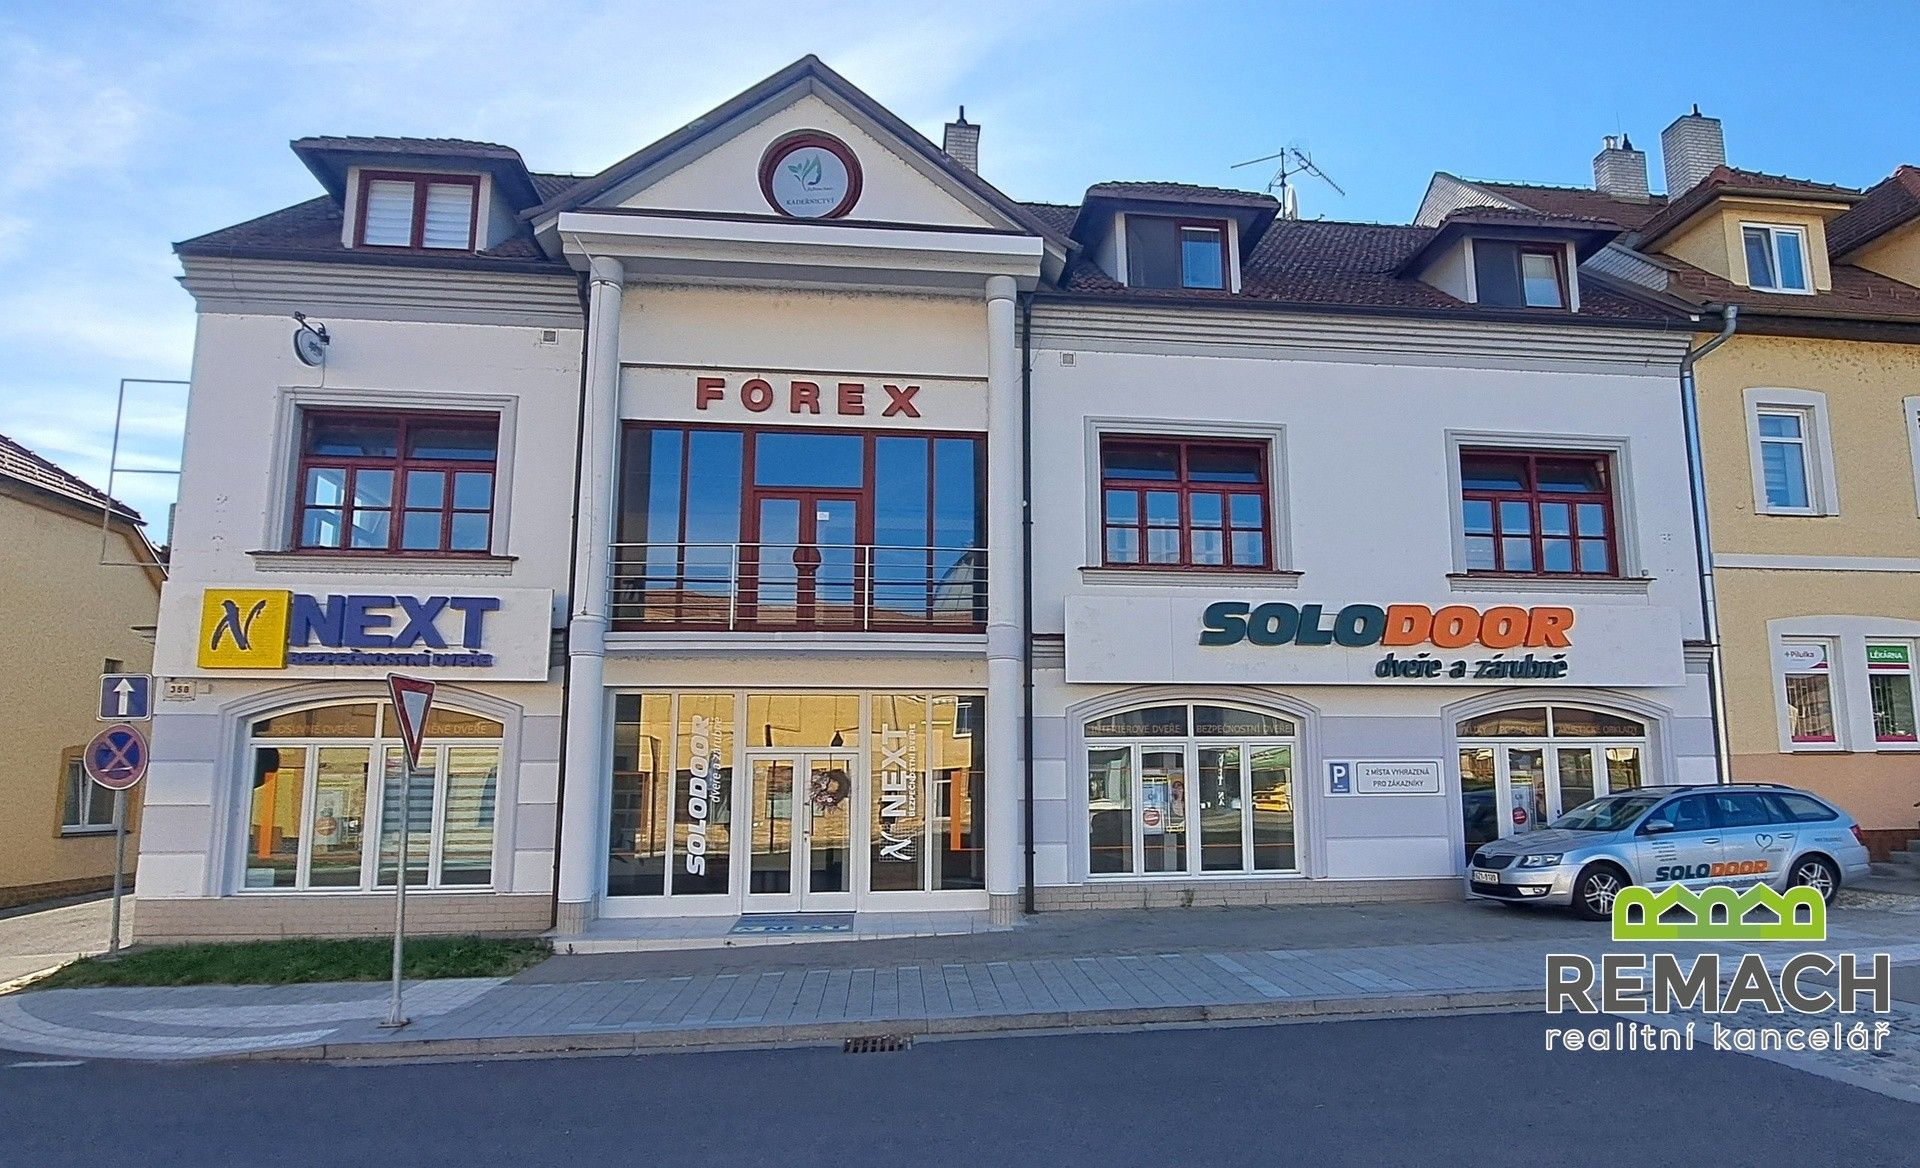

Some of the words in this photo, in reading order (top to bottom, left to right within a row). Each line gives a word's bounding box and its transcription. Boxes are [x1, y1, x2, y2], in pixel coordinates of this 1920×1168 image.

[696, 376, 922, 418] FOREX
[291, 594, 501, 650] NEXT
[1198, 602, 1574, 649] SOLODOOR
[1375, 652, 1443, 679] dveře
[1449, 659, 1467, 679] a
[1473, 652, 1568, 679] zárubně
[881, 723, 908, 818] NEXT
[1333, 765, 1346, 784] P
[1365, 768, 1370, 776] 2
[1371, 767, 1391, 776] MÍSTA
[1392, 767, 1430, 776] VYHRAZENÁ
[1373, 780, 1387, 788] PRO
[1388, 779, 1425, 788] ZÁKAZNÍKY
[686, 714, 710, 877] SOLODOOR
[1655, 860, 1768, 881] SOLODOOR
